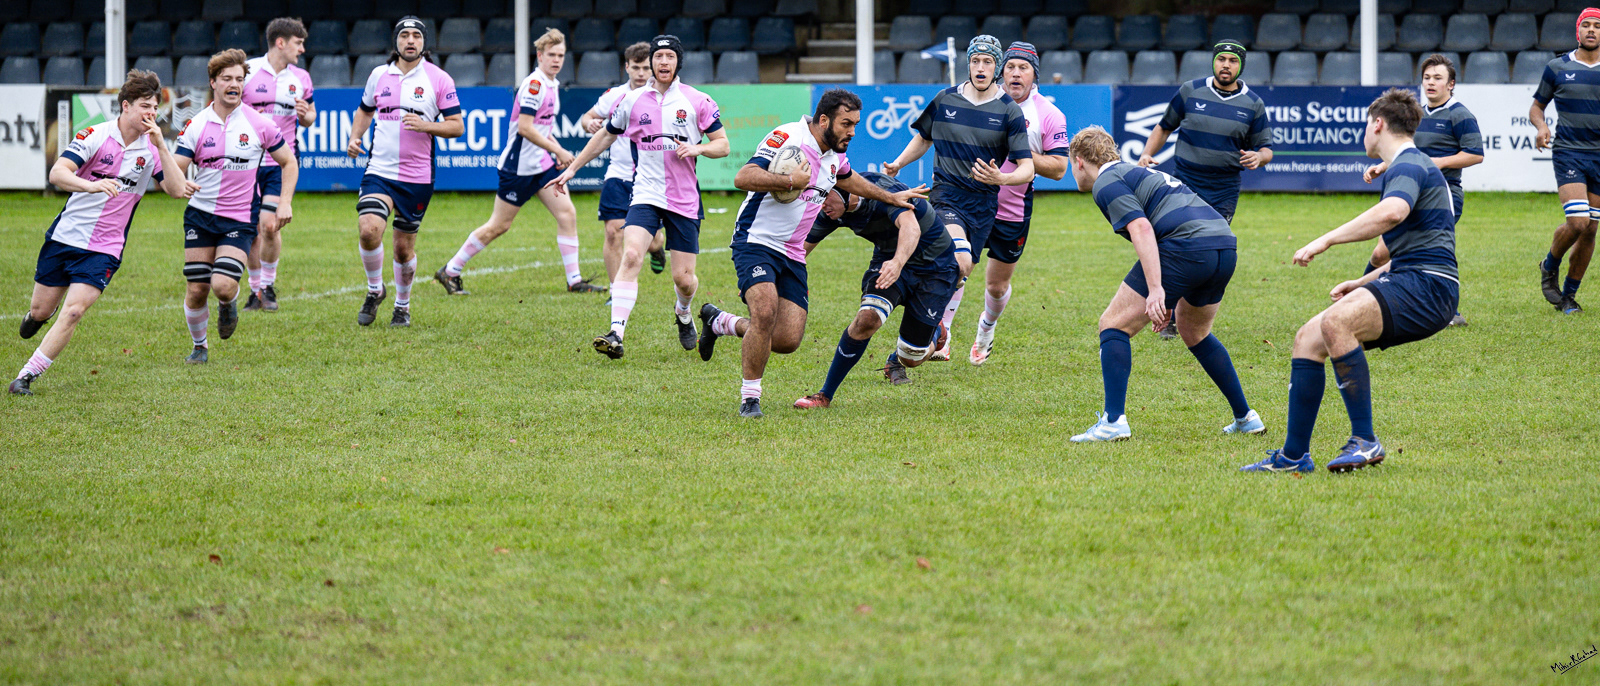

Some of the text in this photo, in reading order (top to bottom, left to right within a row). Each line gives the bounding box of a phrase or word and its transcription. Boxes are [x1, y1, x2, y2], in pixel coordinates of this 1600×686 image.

[1264, 101, 1369, 123] rus Secur
[1511, 117, 1553, 126] PRD
[1272, 127, 1363, 144] SULTANCY
[1482, 136, 1501, 149] HE
[315, 156, 354, 168] TECHNICAL
[436, 155, 451, 168] THE
[451, 155, 486, 168] WORLD'S
